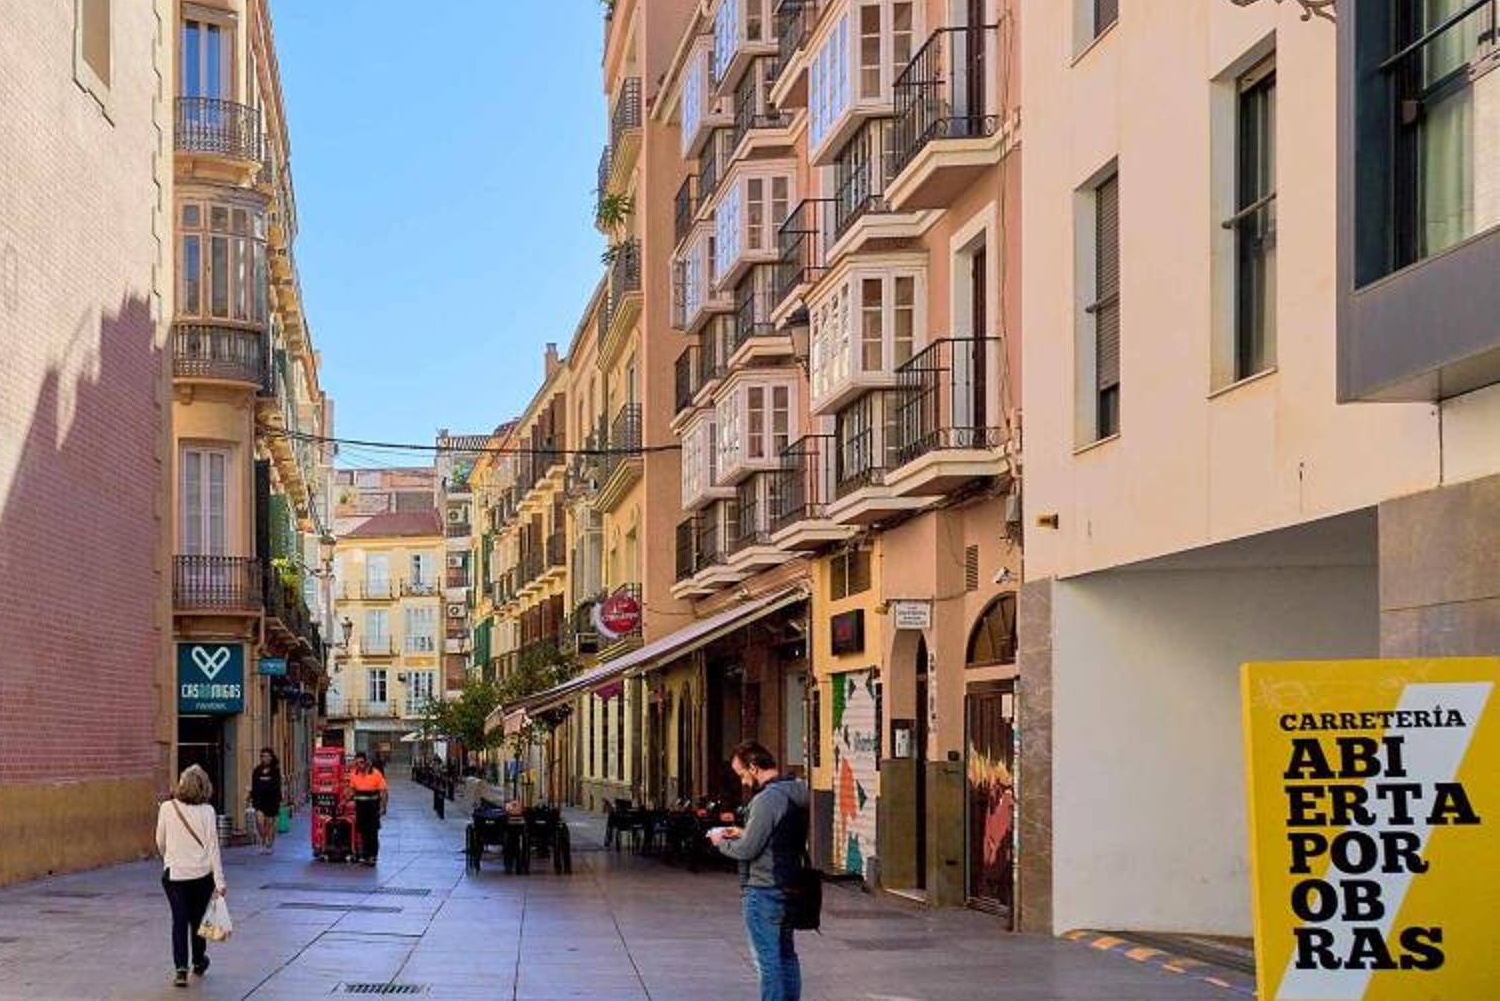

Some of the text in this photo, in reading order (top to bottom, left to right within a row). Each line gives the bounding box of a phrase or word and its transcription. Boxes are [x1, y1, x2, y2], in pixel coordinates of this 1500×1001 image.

[1279, 704, 1467, 732] CARRETERÍA
[1283, 736, 1407, 780] ABI
[1284, 782, 1481, 828] ERTA
[1287, 830, 1430, 875] POR
[1291, 878, 1385, 923] OB
[1293, 926, 1445, 972] RAS
